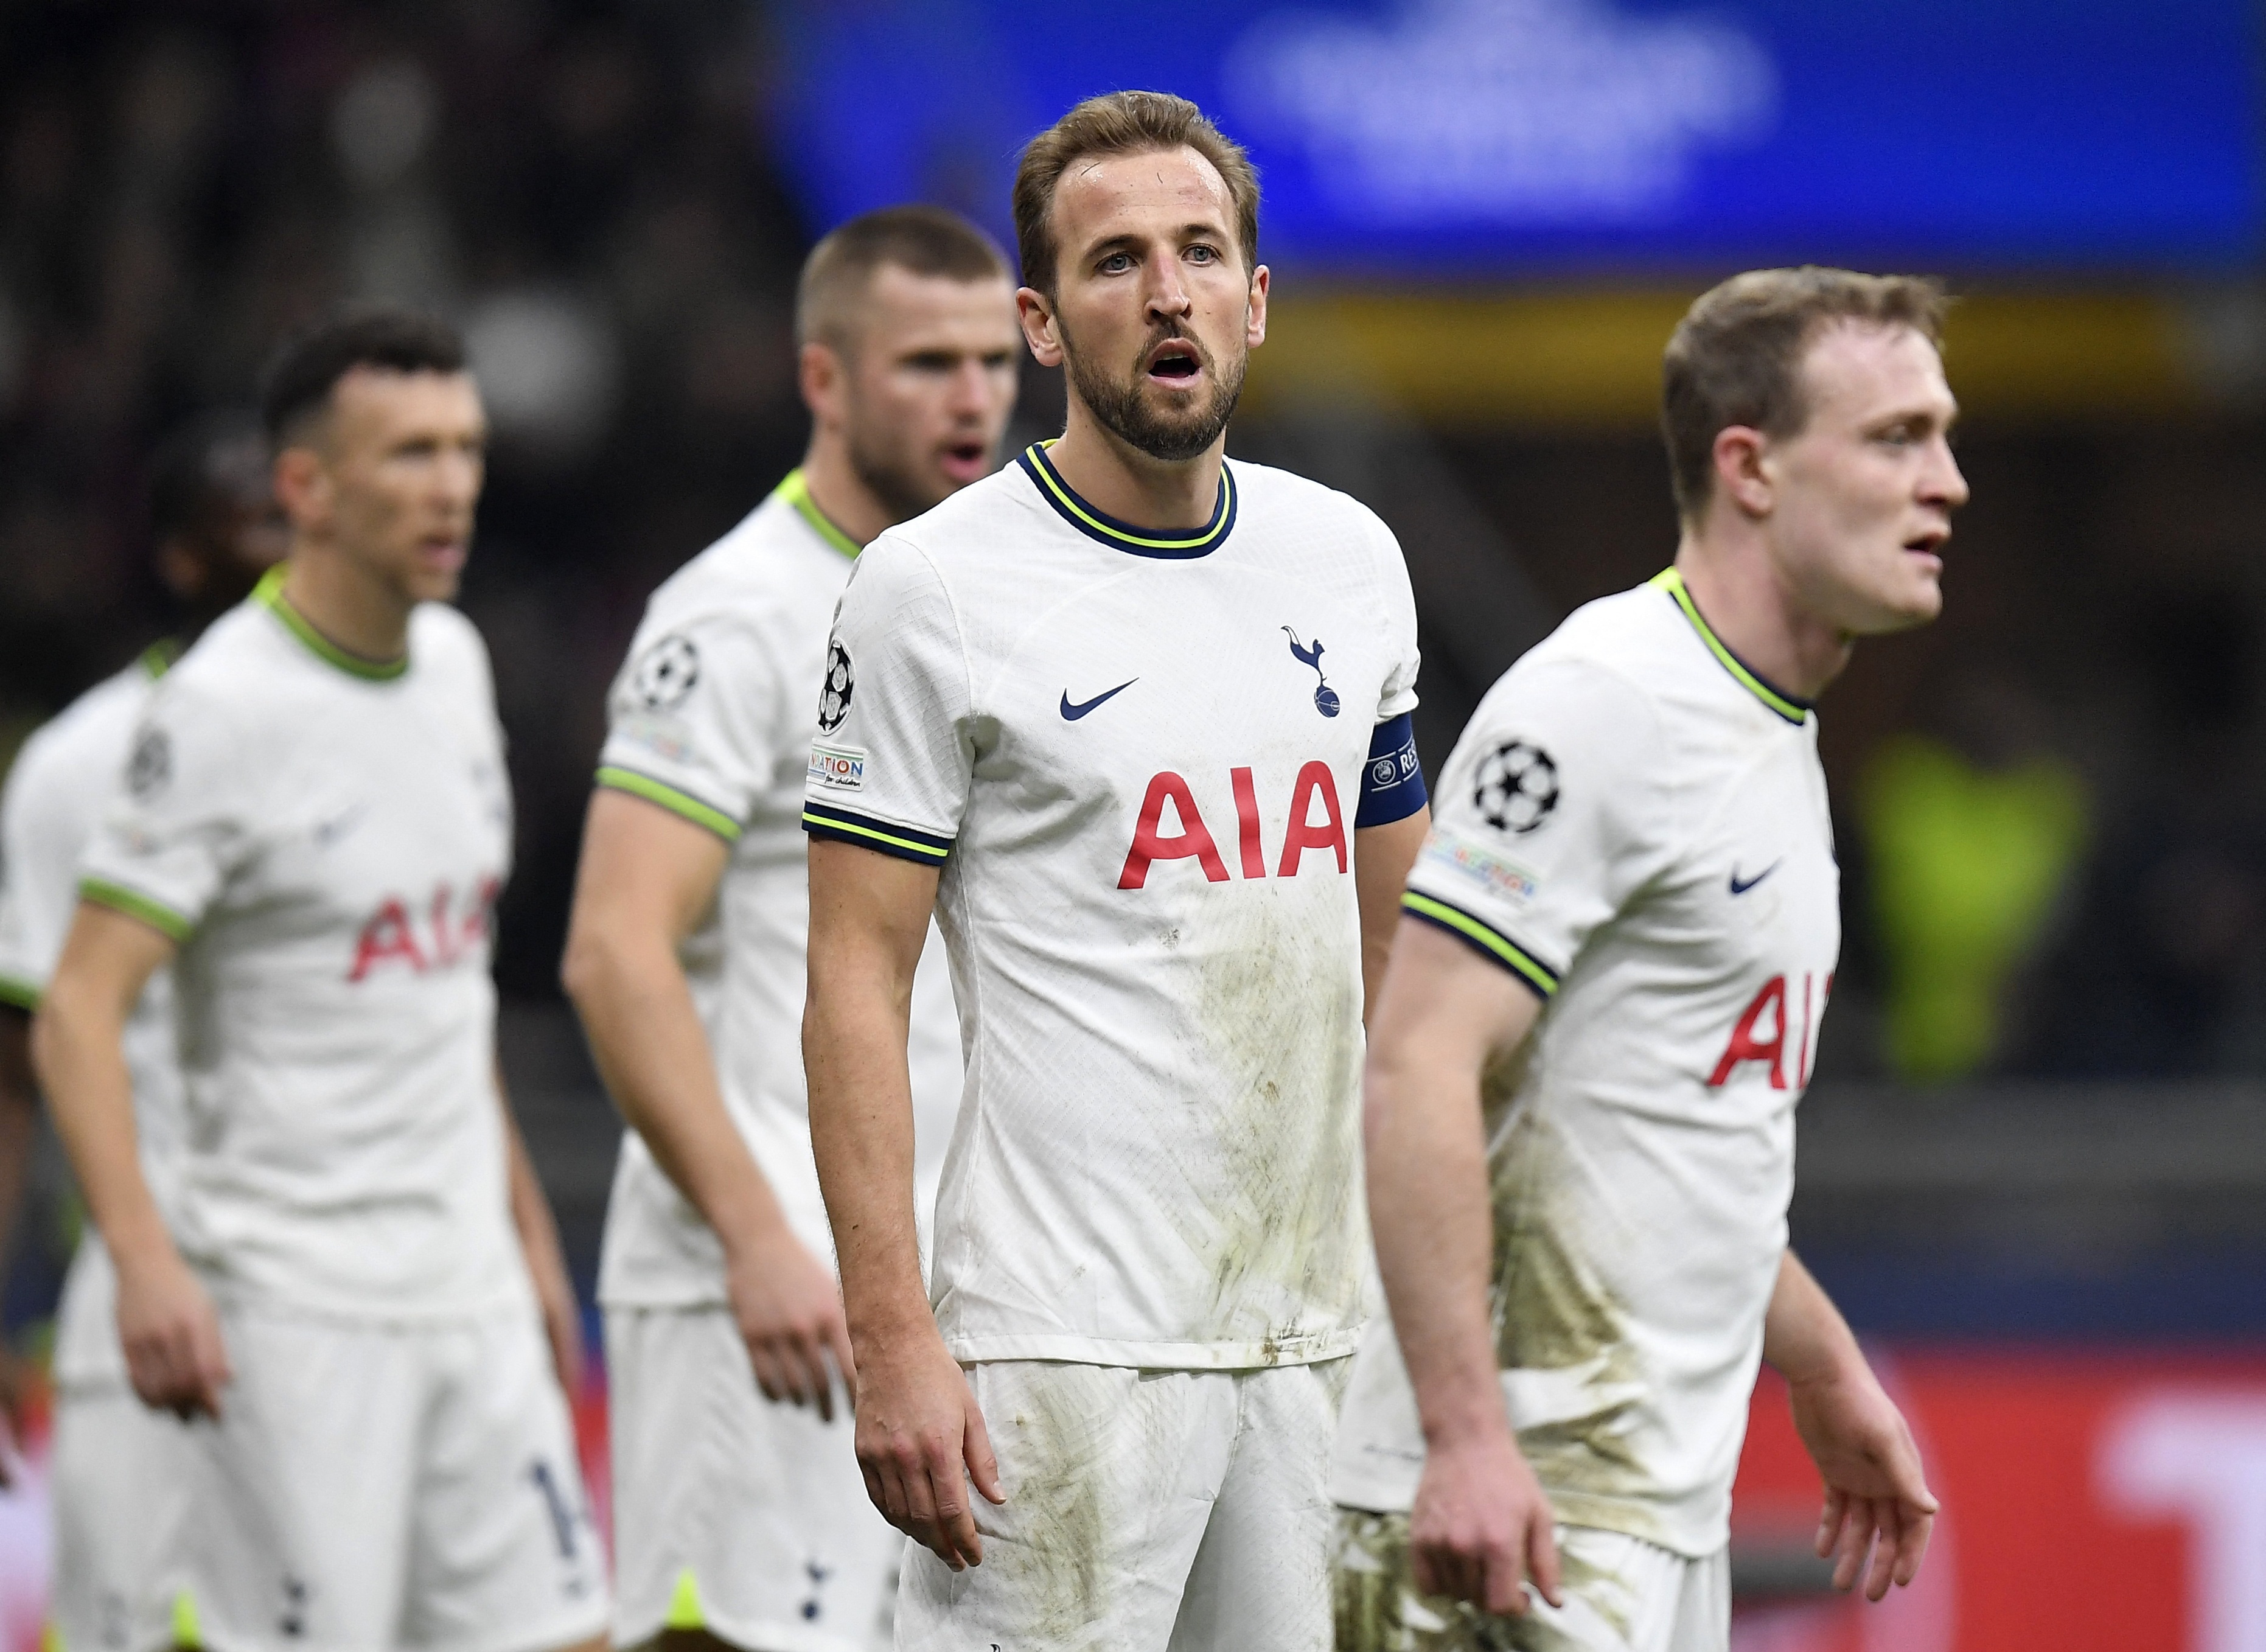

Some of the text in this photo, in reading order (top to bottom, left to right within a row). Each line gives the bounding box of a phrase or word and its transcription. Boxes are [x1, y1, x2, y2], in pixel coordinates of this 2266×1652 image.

[824, 773, 861, 787] for children
[1117, 760, 1348, 890] AIA
[1706, 972, 1835, 1090] AI
